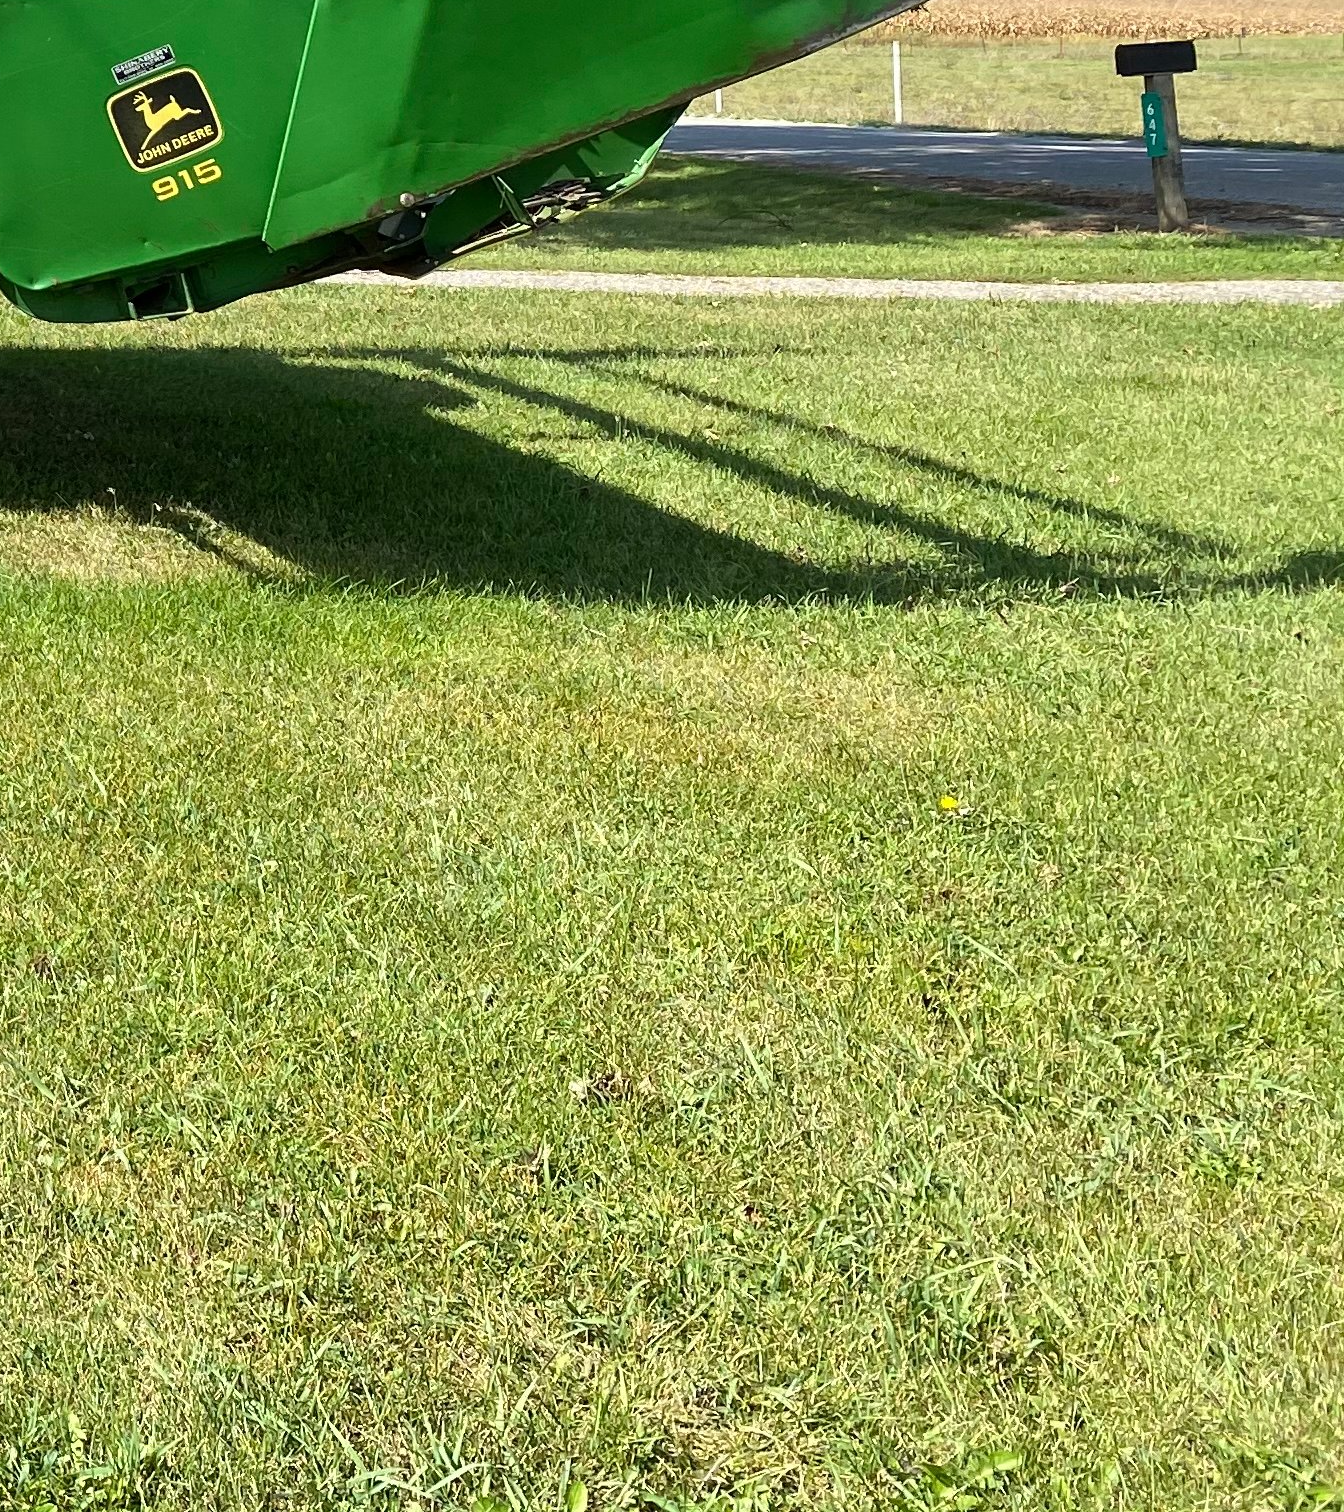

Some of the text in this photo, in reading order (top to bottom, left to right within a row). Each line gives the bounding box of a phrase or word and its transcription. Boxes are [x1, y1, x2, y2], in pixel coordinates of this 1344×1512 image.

[136, 124, 214, 164] JOHN DEERE
[1146, 103, 1157, 146] 647
[152, 158, 222, 201] 915
